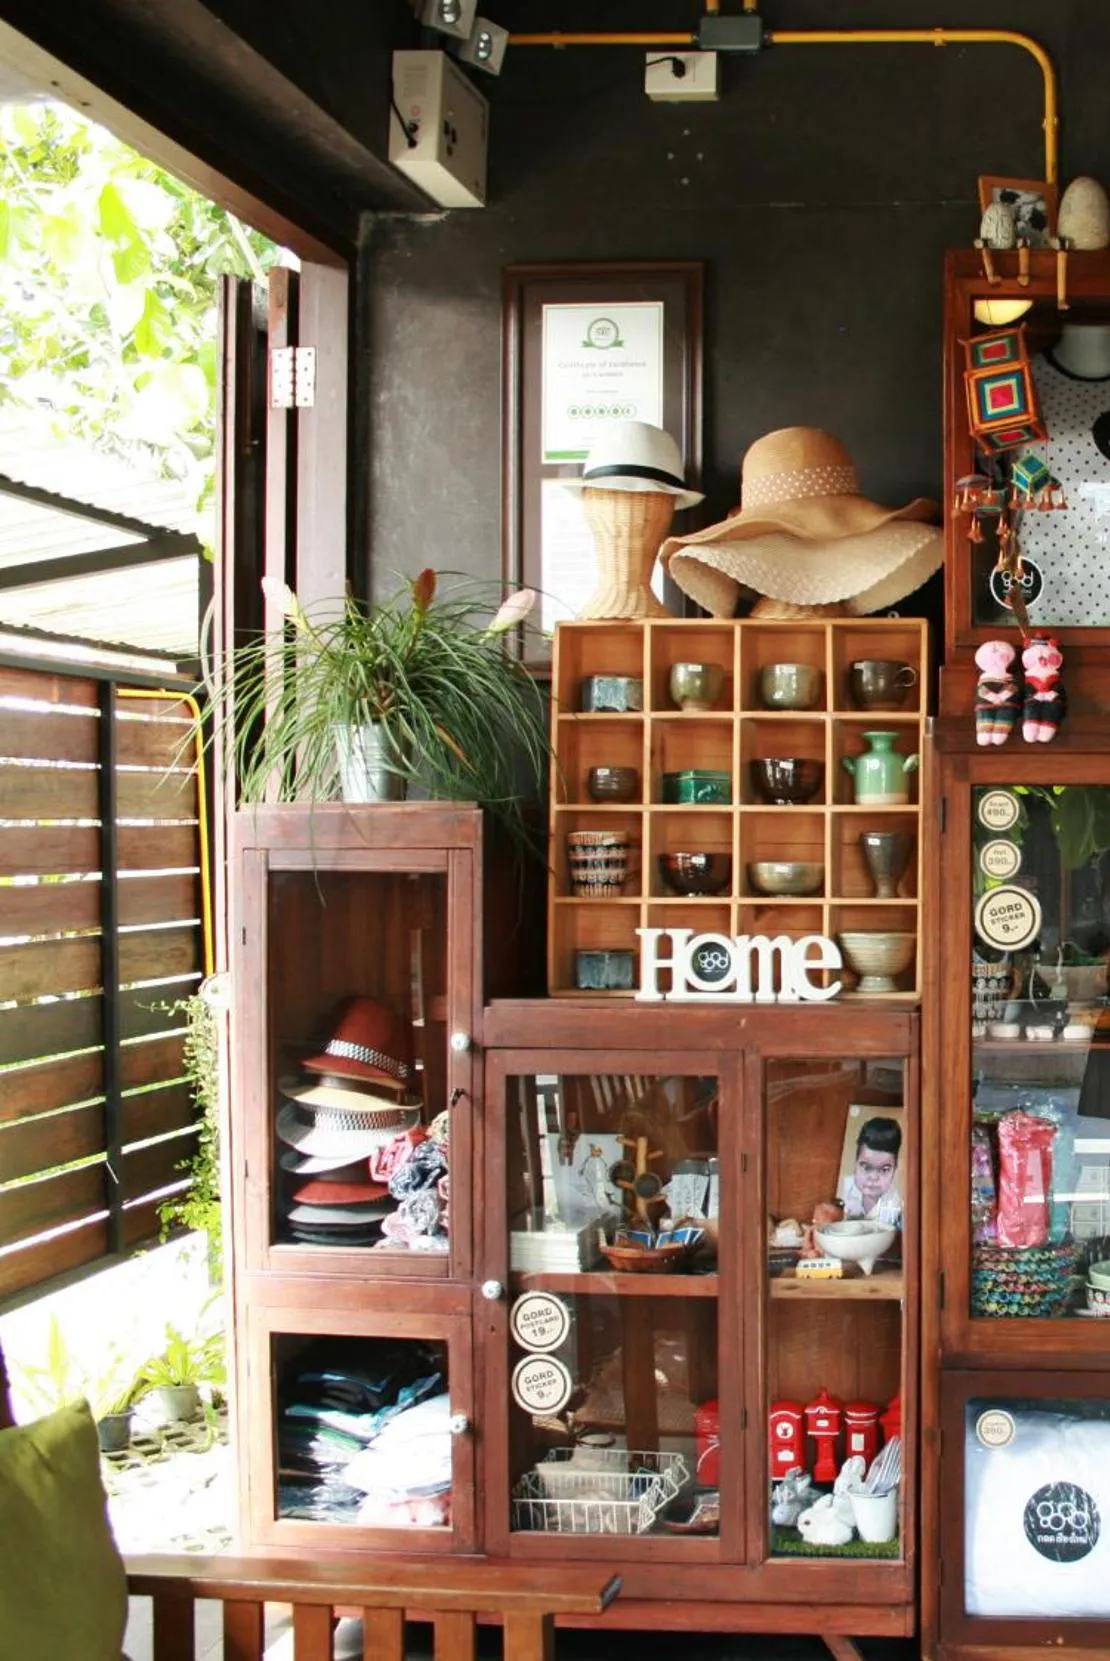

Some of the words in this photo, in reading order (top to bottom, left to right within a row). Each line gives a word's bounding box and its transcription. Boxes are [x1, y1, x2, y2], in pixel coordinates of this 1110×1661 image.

[990, 902, 1023, 918] GORD
[990, 912, 1026, 926] STICKER
[522, 1307, 553, 1322] GORD
[520, 1315, 560, 1330] POSTCARD
[524, 1370, 554, 1385] GORD
[526, 1378, 557, 1393] STICKER
